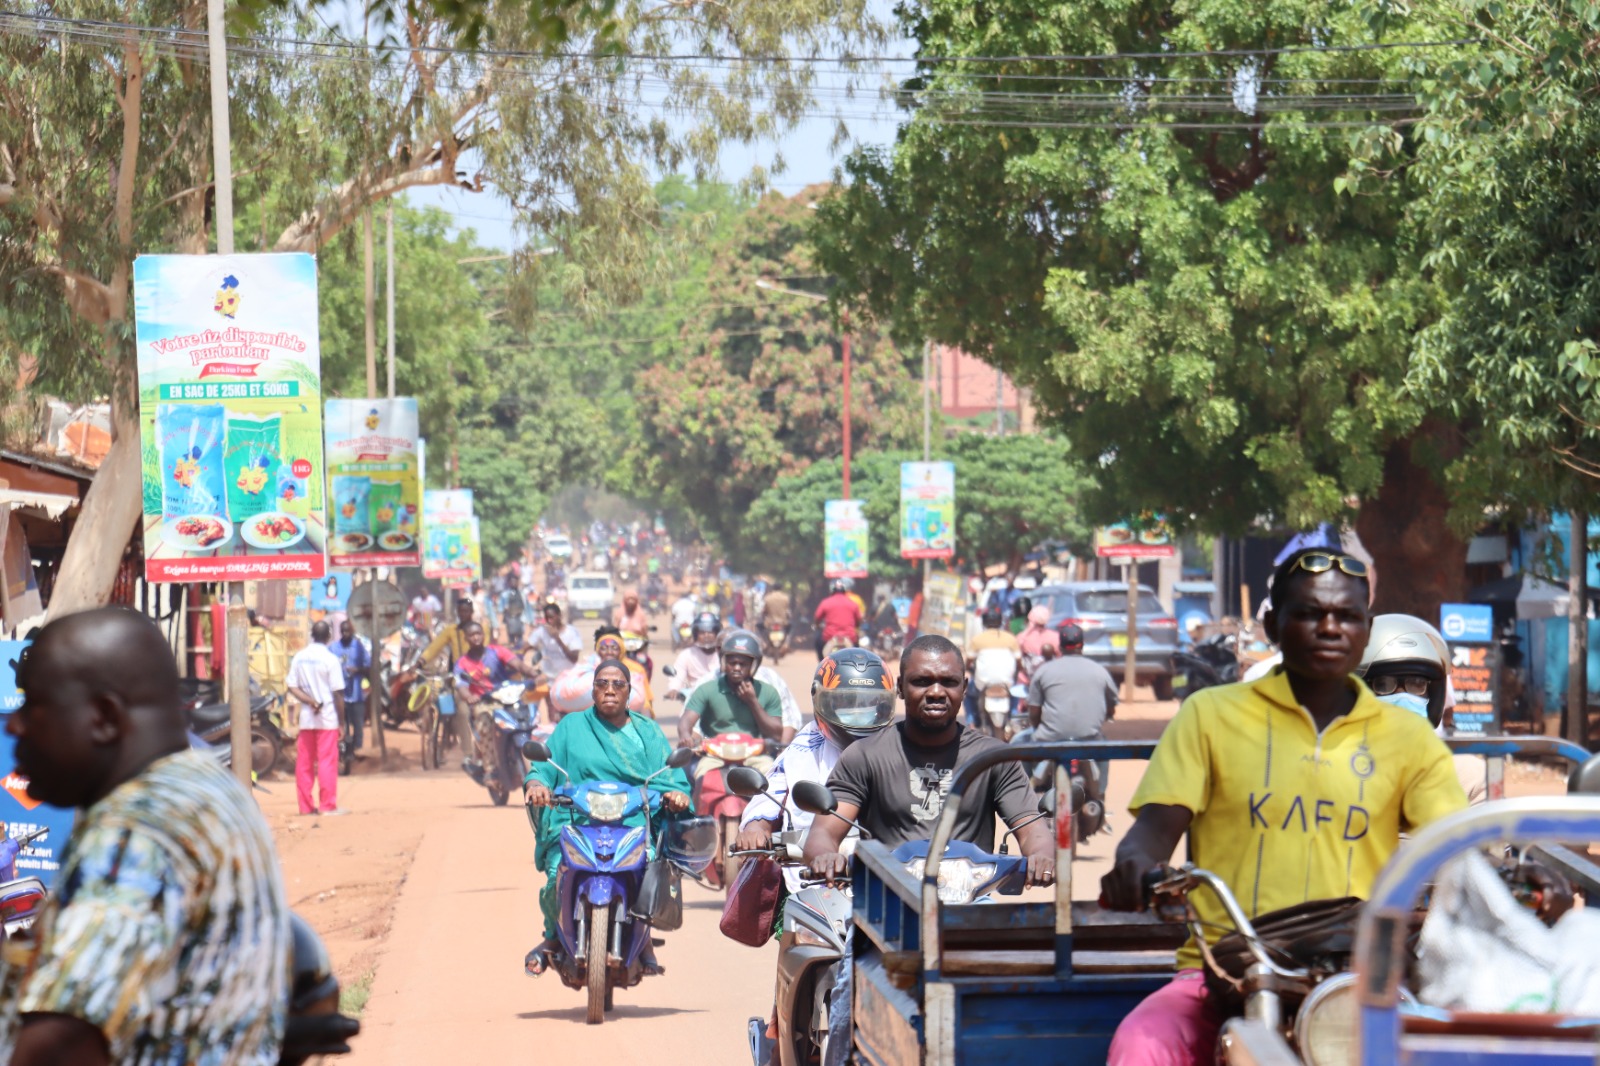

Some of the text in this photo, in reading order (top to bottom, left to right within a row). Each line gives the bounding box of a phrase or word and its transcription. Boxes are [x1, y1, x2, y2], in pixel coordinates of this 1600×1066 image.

[149, 326, 307, 355] Votre riz disponible
[189, 343, 270, 366] partout au
[169, 382, 290, 398] EN SAC DE 25KG ET 50KG
[190, 564, 198, 574] la
[199, 565, 226, 576] marque
[226, 562, 269, 574] DARLING
[270, 560, 313, 573] MOTHER
[1248, 792, 1370, 841] KAFD
